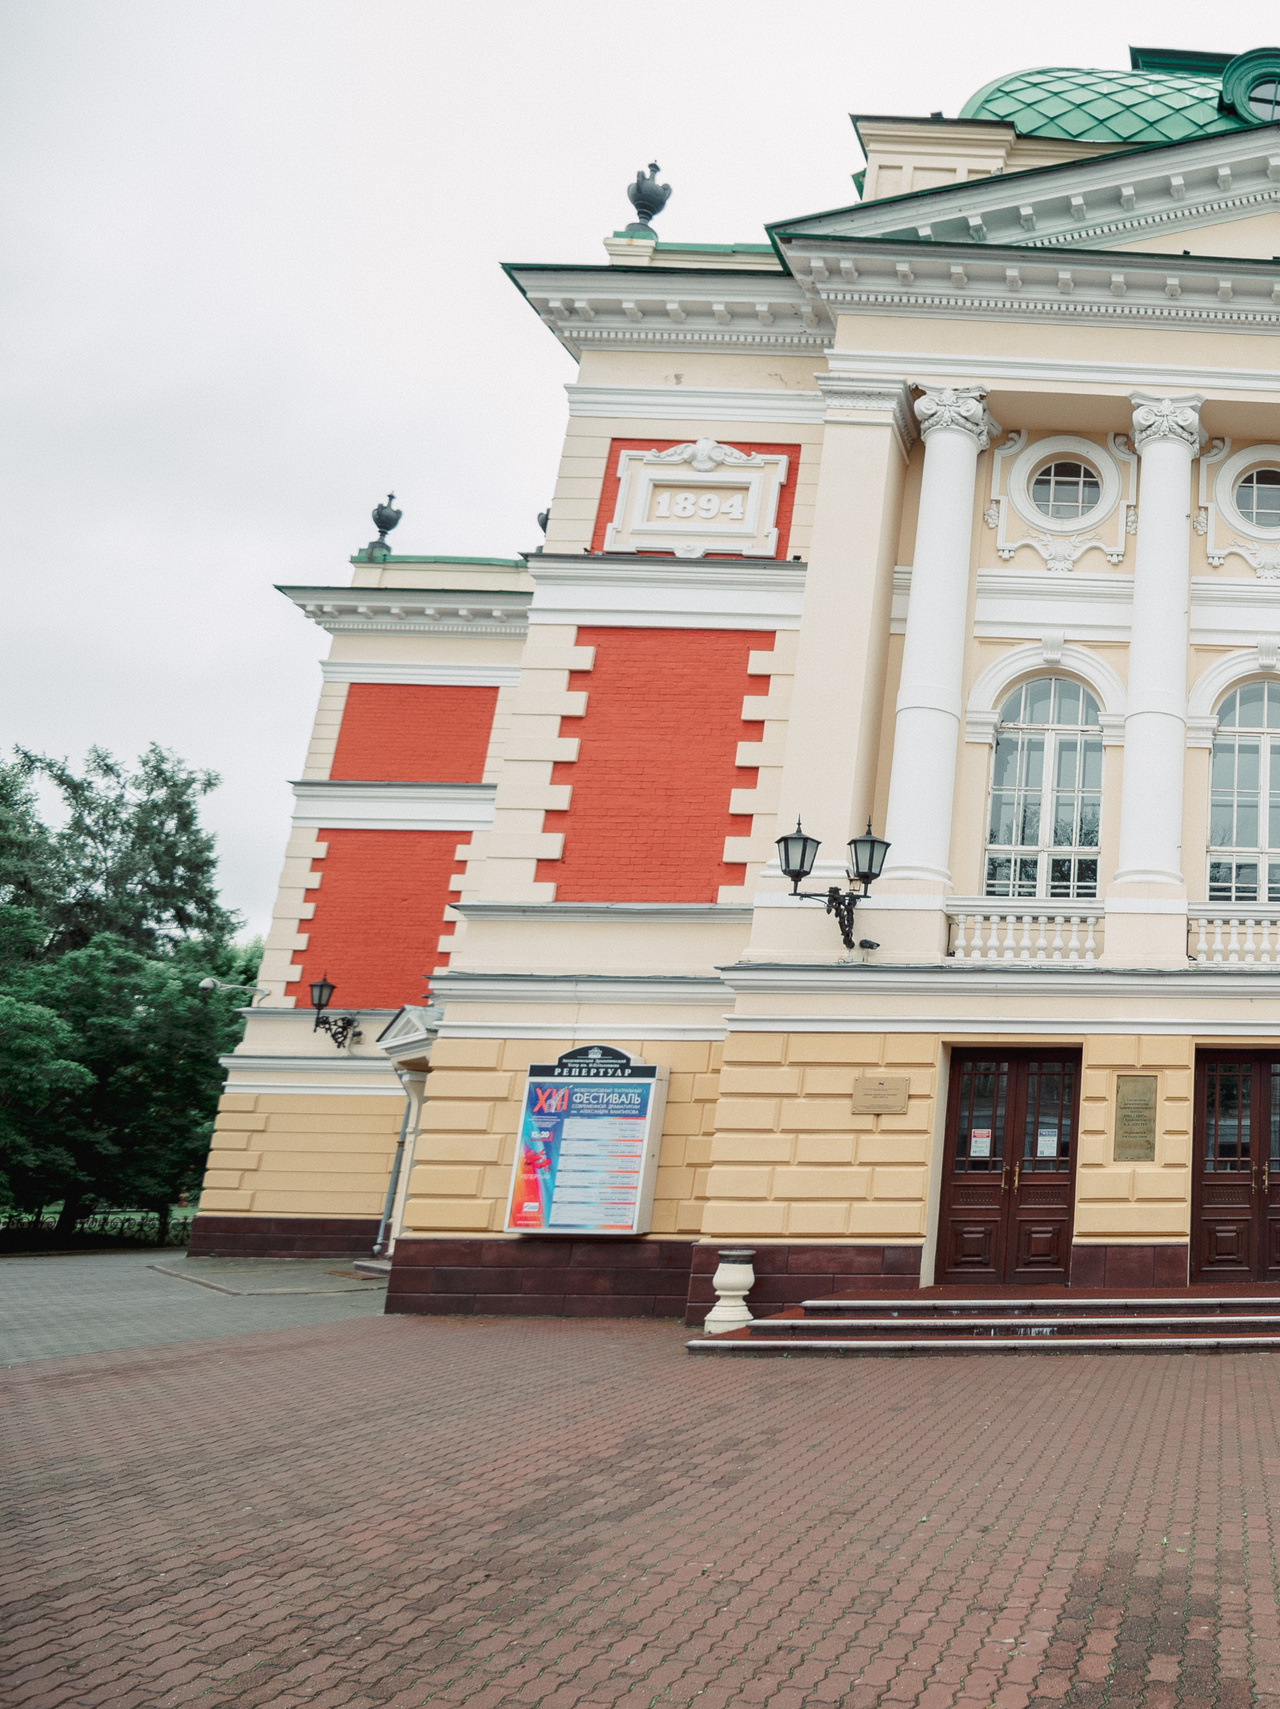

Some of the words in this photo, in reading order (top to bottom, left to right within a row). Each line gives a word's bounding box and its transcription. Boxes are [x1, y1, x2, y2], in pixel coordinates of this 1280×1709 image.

[655, 492, 744, 519] 1894
[554, 1068, 632, 1076] РЕПЕРТУАР
[572, 1092, 641, 1104] ФЕСТИВАЛЬ
